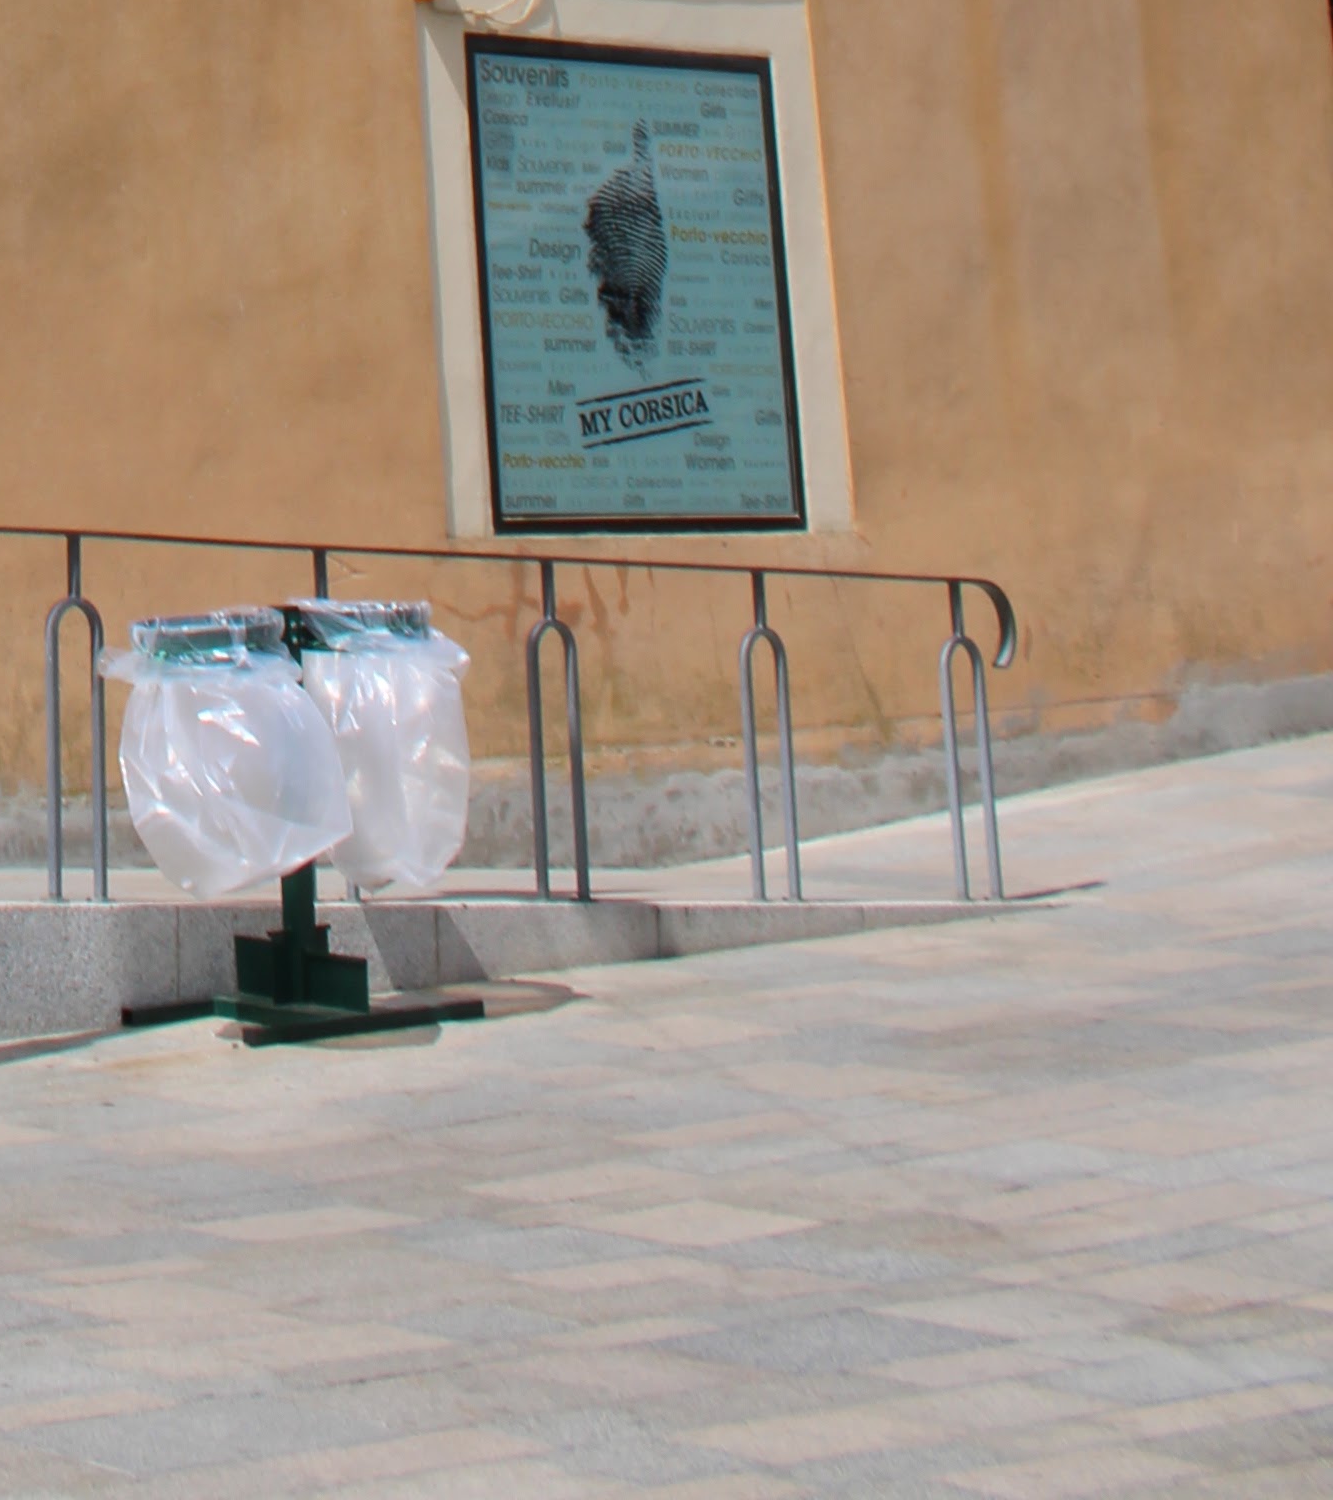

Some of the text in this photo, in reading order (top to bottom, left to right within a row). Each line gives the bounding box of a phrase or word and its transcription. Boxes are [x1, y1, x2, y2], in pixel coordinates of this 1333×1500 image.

[479, 58, 570, 88] Souvenirs
[670, 221, 768, 246] Porto-vecchio
[529, 237, 581, 264] Design
[579, 390, 710, 438] MY CORSICA
[502, 452, 585, 470] Porto-vecchio
